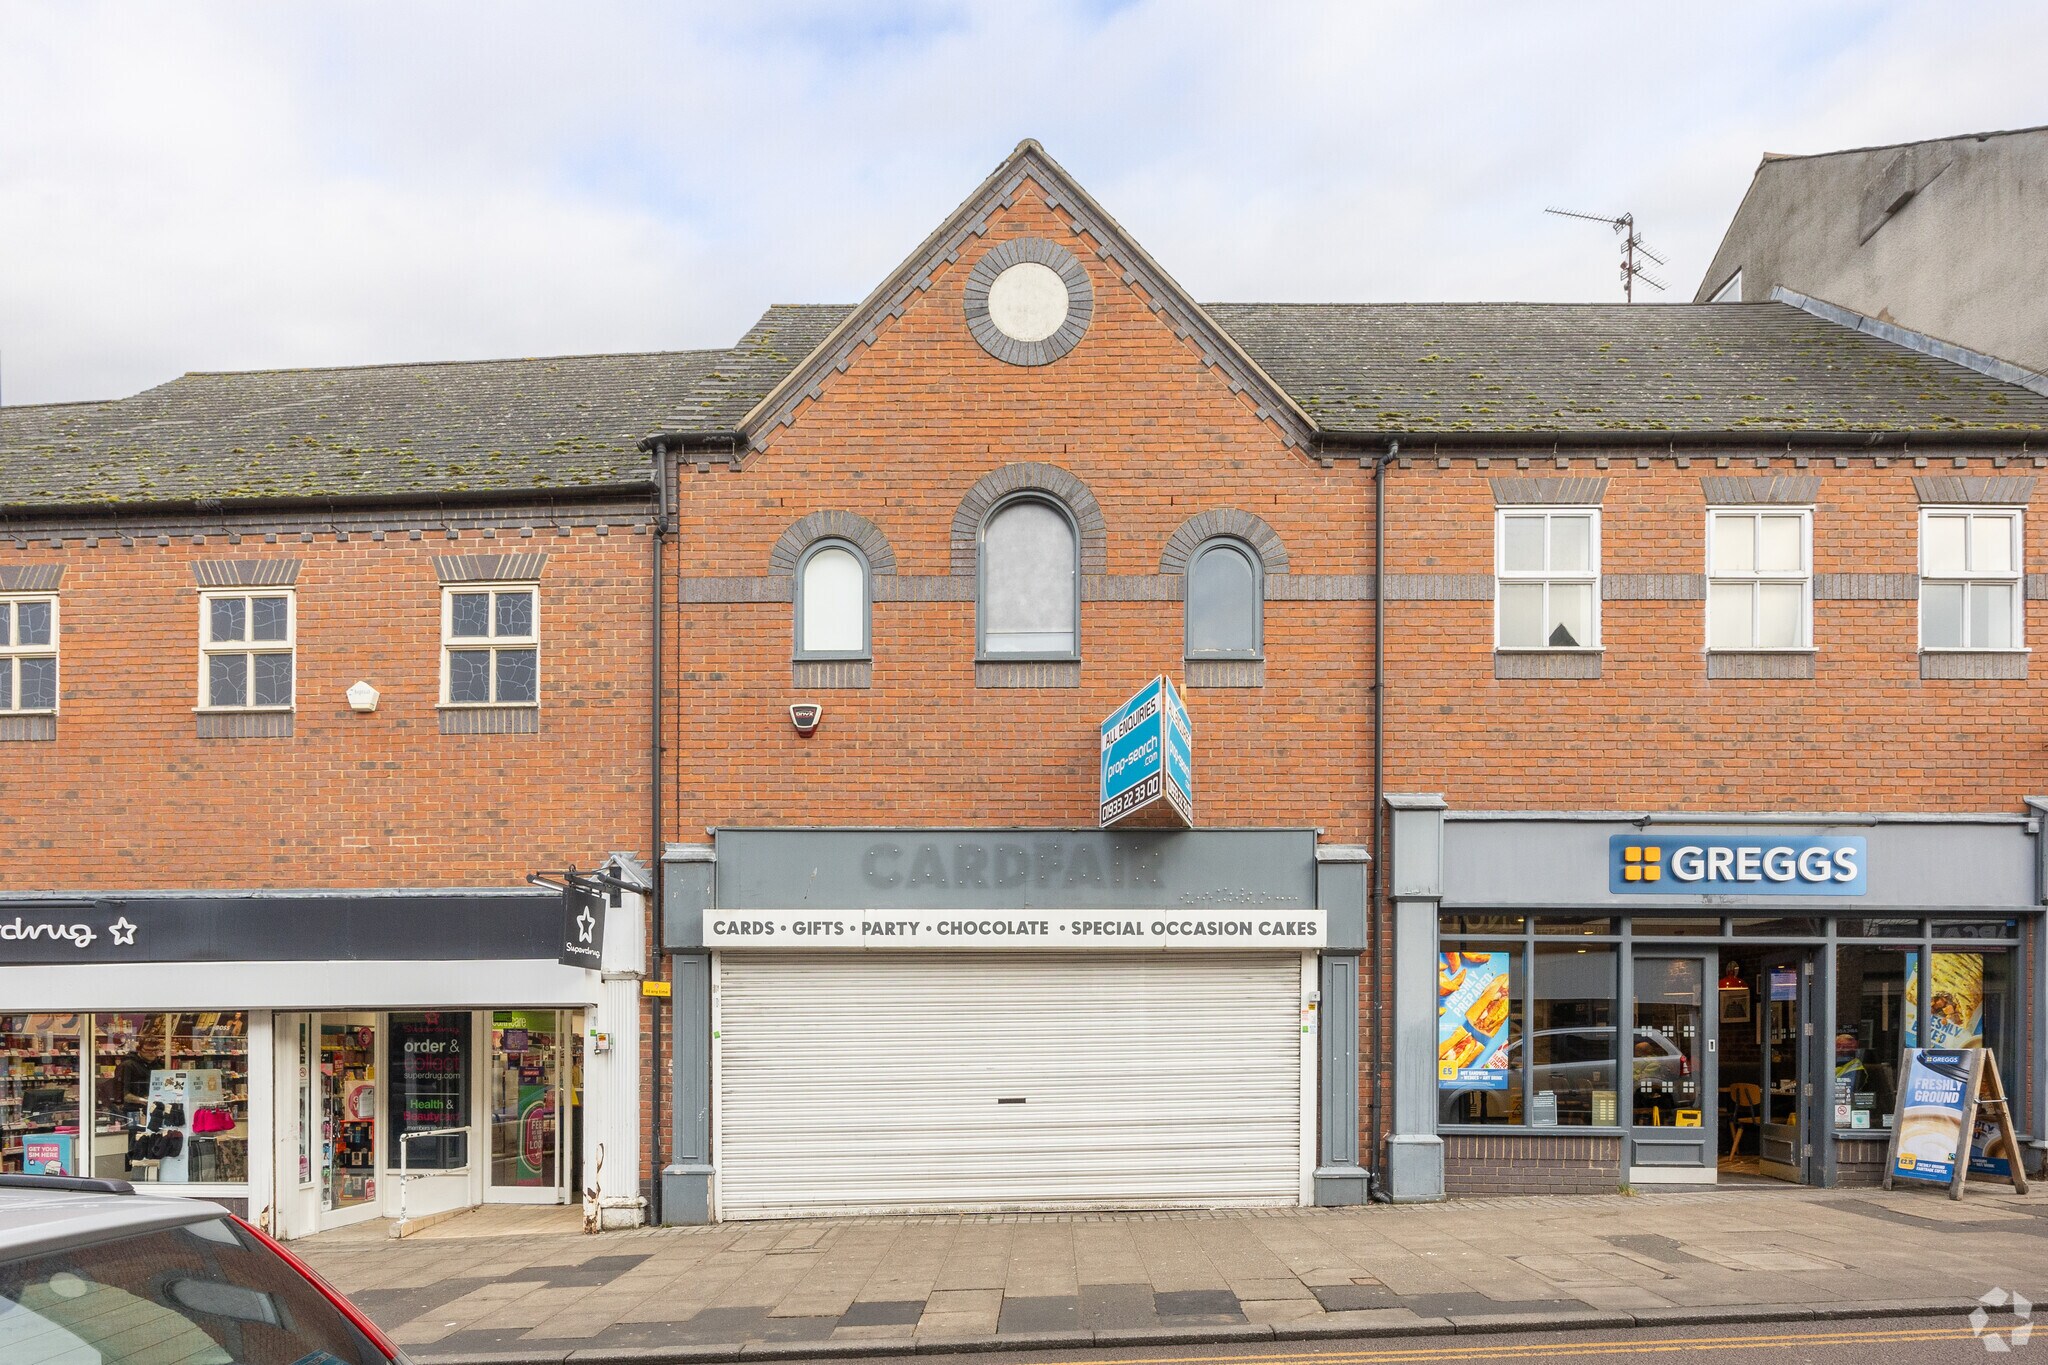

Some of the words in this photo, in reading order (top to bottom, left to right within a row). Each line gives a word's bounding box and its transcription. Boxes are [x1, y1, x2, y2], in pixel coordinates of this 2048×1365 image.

[1105, 730, 1118, 748] ALL
[1119, 697, 1156, 736] ENQUIRIES
[1107, 735, 1158, 782] prop-search
[1144, 751, 1158, 767] .com
[1102, 797, 1123, 821] 01933
[1124, 792, 1134, 812] 22
[1135, 785, 1145, 805] 33
[1147, 776, 1158, 797] 00
[1671, 846, 1858, 882] GREGGS
[0, 917, 97, 948] drug
[713, 920, 775, 936] CARDS
[792, 920, 845, 936] GIFTS
[861, 920, 920, 936] PARTY
[936, 920, 1049, 936] CHOCOLATE
[1071, 920, 1144, 936] SPECIAL
[1150, 920, 1252, 936] OCCASION
[1258, 920, 1317, 936] CAKES
[566, 942, 601, 959] Superdrug
[1444, 970, 1479, 1010] FRESHLY
[1452, 972, 1494, 1018] PREPARED
[1930, 1015, 1962, 1037] ESHLY
[404, 1039, 446, 1053] order
[449, 1039, 460, 1053] &
[404, 1053, 460, 1071] collect
[404, 1072, 461, 1081] superdrug.com
[1442, 1067, 1453, 1075] £5
[1914, 1078, 1963, 1092] FRESHLY
[410, 1099, 444, 1109] Health
[446, 1099, 454, 1110] &
[1914, 1090, 1960, 1104] GROUND
